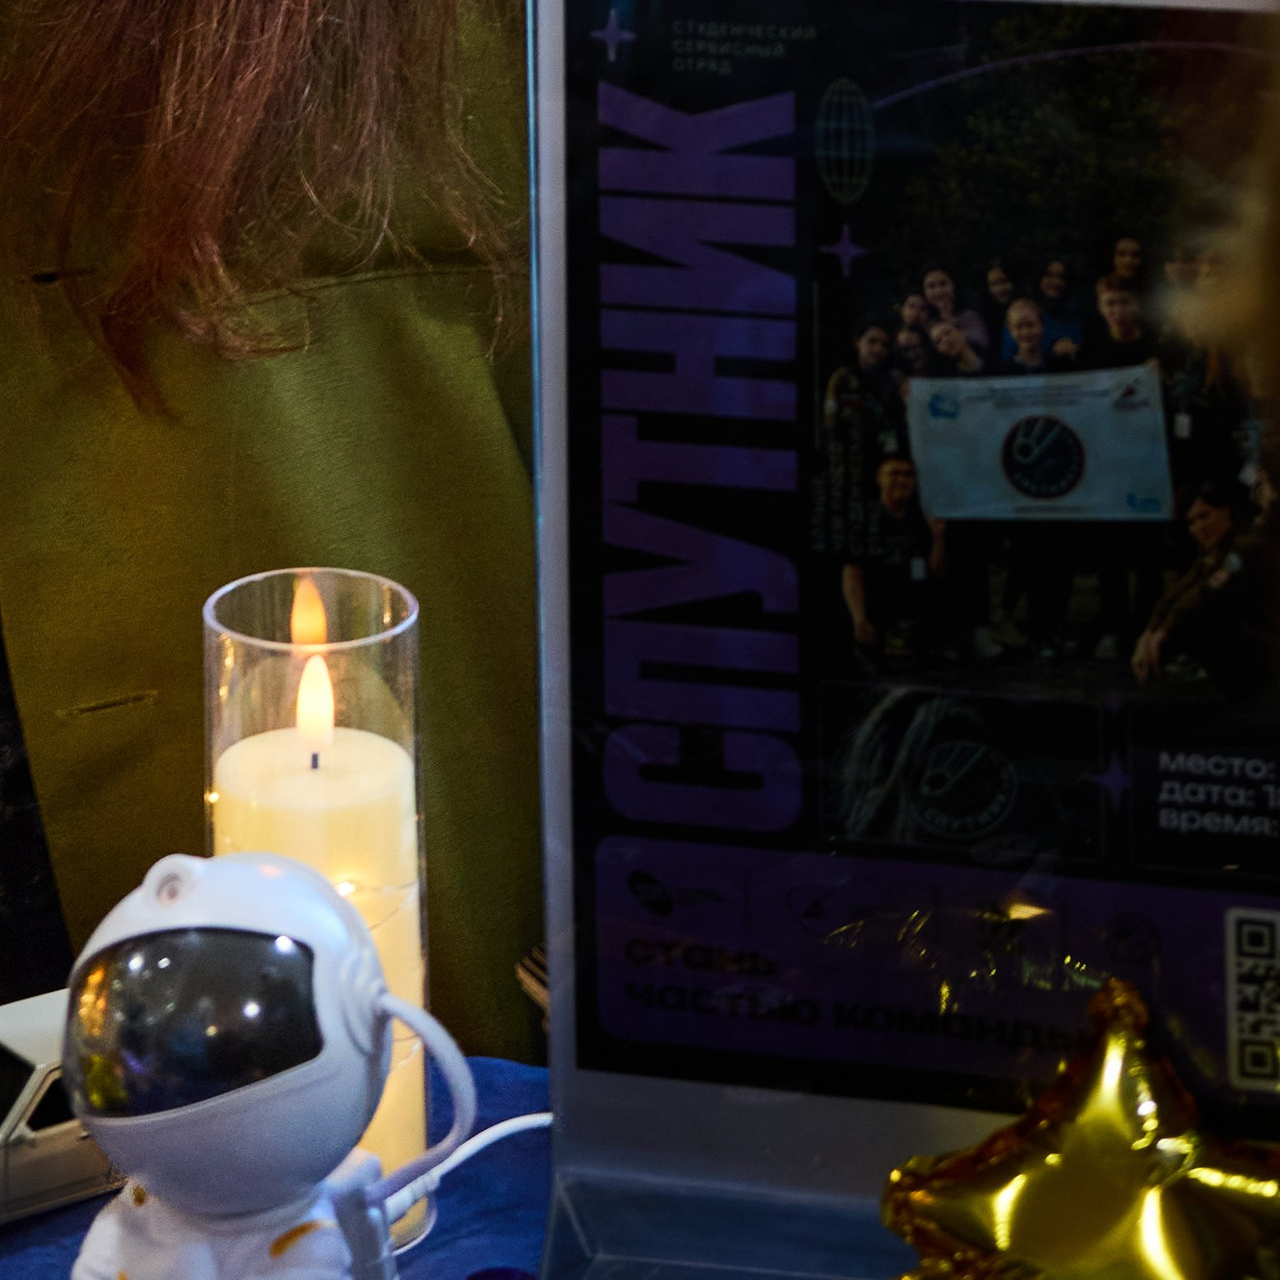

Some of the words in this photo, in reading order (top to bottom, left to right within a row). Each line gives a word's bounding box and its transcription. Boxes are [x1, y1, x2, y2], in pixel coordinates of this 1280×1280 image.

[597, 79, 803, 835] СПУТНИК
[1158, 751, 1277, 781] место:
[1158, 780, 1256, 809] дата:
[1158, 806, 1279, 839] время:
